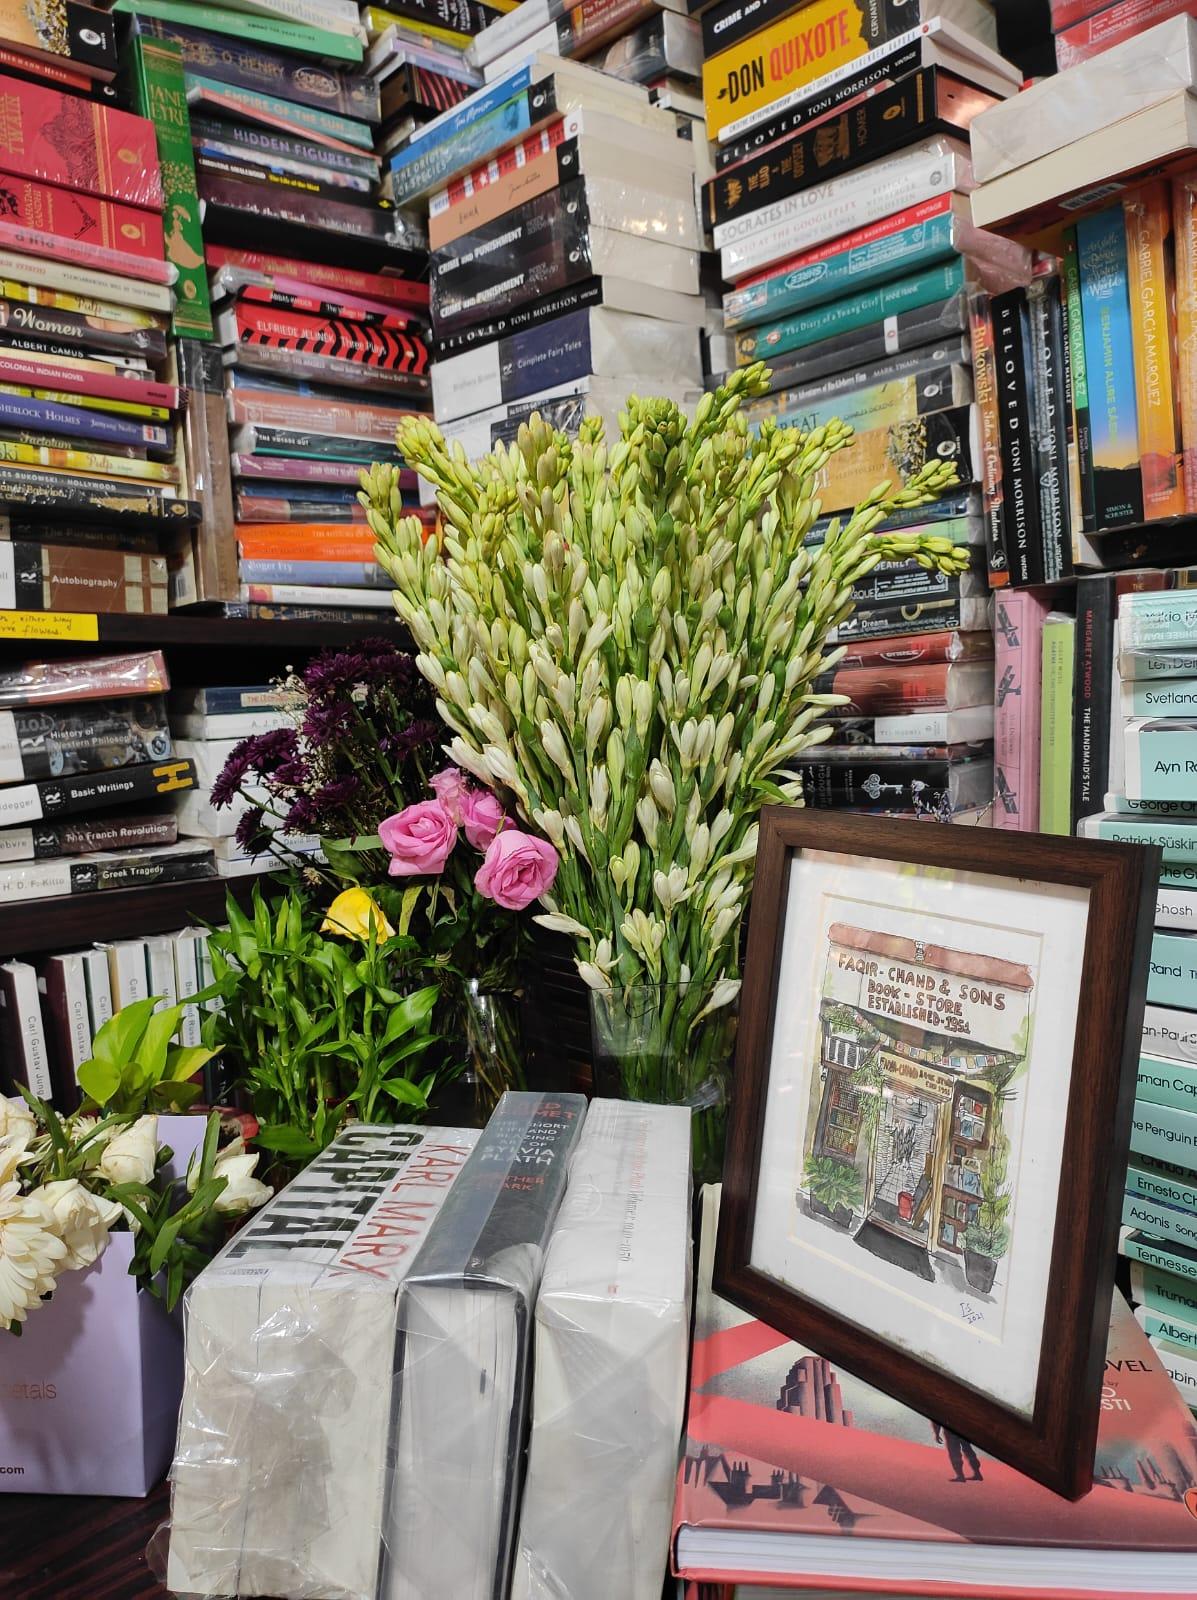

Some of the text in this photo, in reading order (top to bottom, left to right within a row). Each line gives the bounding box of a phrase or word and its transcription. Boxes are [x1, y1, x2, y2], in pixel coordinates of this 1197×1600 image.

[713, 2, 761, 34] CRIME AND
[728, 9, 852, 104] DON QUIXOTE
[807, 98, 832, 117] TONI
[835, 64, 890, 101] MORRISON
[894, 51, 917, 67] VINTAGE
[224, 89, 344, 130] EMPIRE OF THE SUN
[233, 128, 290, 152] HIDDEN
[293, 144, 354, 168] FIGURES
[409, 162, 447, 190] SPECIES
[748, 174, 758, 191] THE
[721, 206, 783, 243] SOCRATES
[784, 199, 799, 214] IN
[802, 183, 835, 208] LOVE
[916, 201, 943, 218] VINTAGE
[438, 226, 523, 275] CRIME PUNISHMENT
[808, 254, 819, 262] THE
[819, 247, 840, 259] HOUND
[851, 237, 863, 246] THE
[864, 217, 906, 243] BASKERVILLES
[1138, 230, 1153, 287] GABRIEL
[326, 304, 338, 313] The
[440, 299, 462, 318] CRIME
[476, 273, 525, 306] PUNISHMENT
[510, 312, 532, 326] TONI
[533, 295, 578, 317] MORRISON
[580, 288, 599, 300] VINTAGE
[13, 307, 84, 338] Women
[786, 326, 799, 336] The
[800, 319, 822, 334] Diary
[837, 304, 861, 320] Young
[861, 296, 879, 311] Girl
[11, 339, 84, 359] ALBERT CAMUS
[256, 320, 364, 350] ELFRIEDE JELINEK Three
[1101, 308, 1113, 367] BENJAMIN
[517, 339, 582, 369] Complete Fairy Tales
[873, 359, 919, 377] MARK TWAIN
[974, 326, 993, 404] Bukowski
[36, 365, 62, 379] INDIAN
[61, 369, 85, 383] NOVEL
[1001, 309, 1020, 430] BELOVED
[789, 391, 798, 401] The
[855, 372, 867, 384] Finn
[45, 410, 82, 426] HOLMES
[983, 410, 995, 439] Tales
[20, 430, 73, 450] Factotum
[87, 453, 114, 470] Pulp
[1010, 438, 1022, 473] TONI
[14, 472, 118, 491] BUKOWSKI HOLLYWOOD
[986, 454, 999, 495] Ordinary
[1047, 426, 1063, 538] TONI MORRISON
[990, 497, 1004, 541] Madness
[1013, 479, 1028, 549] MORRISON
[1104, 509, 1134, 520] SCHUSTER
[1106, 505, 1126, 514] SIMON
[52, 574, 118, 588] Autobiography
[861, 618, 889, 629] Dreams
[1082, 609, 1094, 802] MARGARET ATWOOD THE HANDMAID'S TALE
[51, 727, 94, 740] History of
[1154, 759, 1182, 776] Ayn
[70, 781, 135, 799] Basic Writings
[1127, 800, 1178, 815] George
[66, 824, 168, 842] The French Revolution
[3, 882, 12, 892] H.
[16, 881, 28, 891] D.
[42, 878, 65, 888] Kitto
[102, 864, 165, 880] Greek Tragedy
[1149, 961, 1182, 977] Rand
[98, 995, 108, 1016] Carl
[868, 978, 963, 1016] BOOK STORE
[939, 978, 951, 995] &
[959, 984, 1006, 1010] SONS
[73, 1001, 88, 1056] Carl Gustav
[27, 1015, 45, 1097] Carl Gustav Jung
[1145, 1122, 1193, 1146] Penguin
[397, 1143, 469, 1193] KARL
[1137, 1177, 1181, 1200] Ernesto
[1129, 1207, 1170, 1230] Adonis
